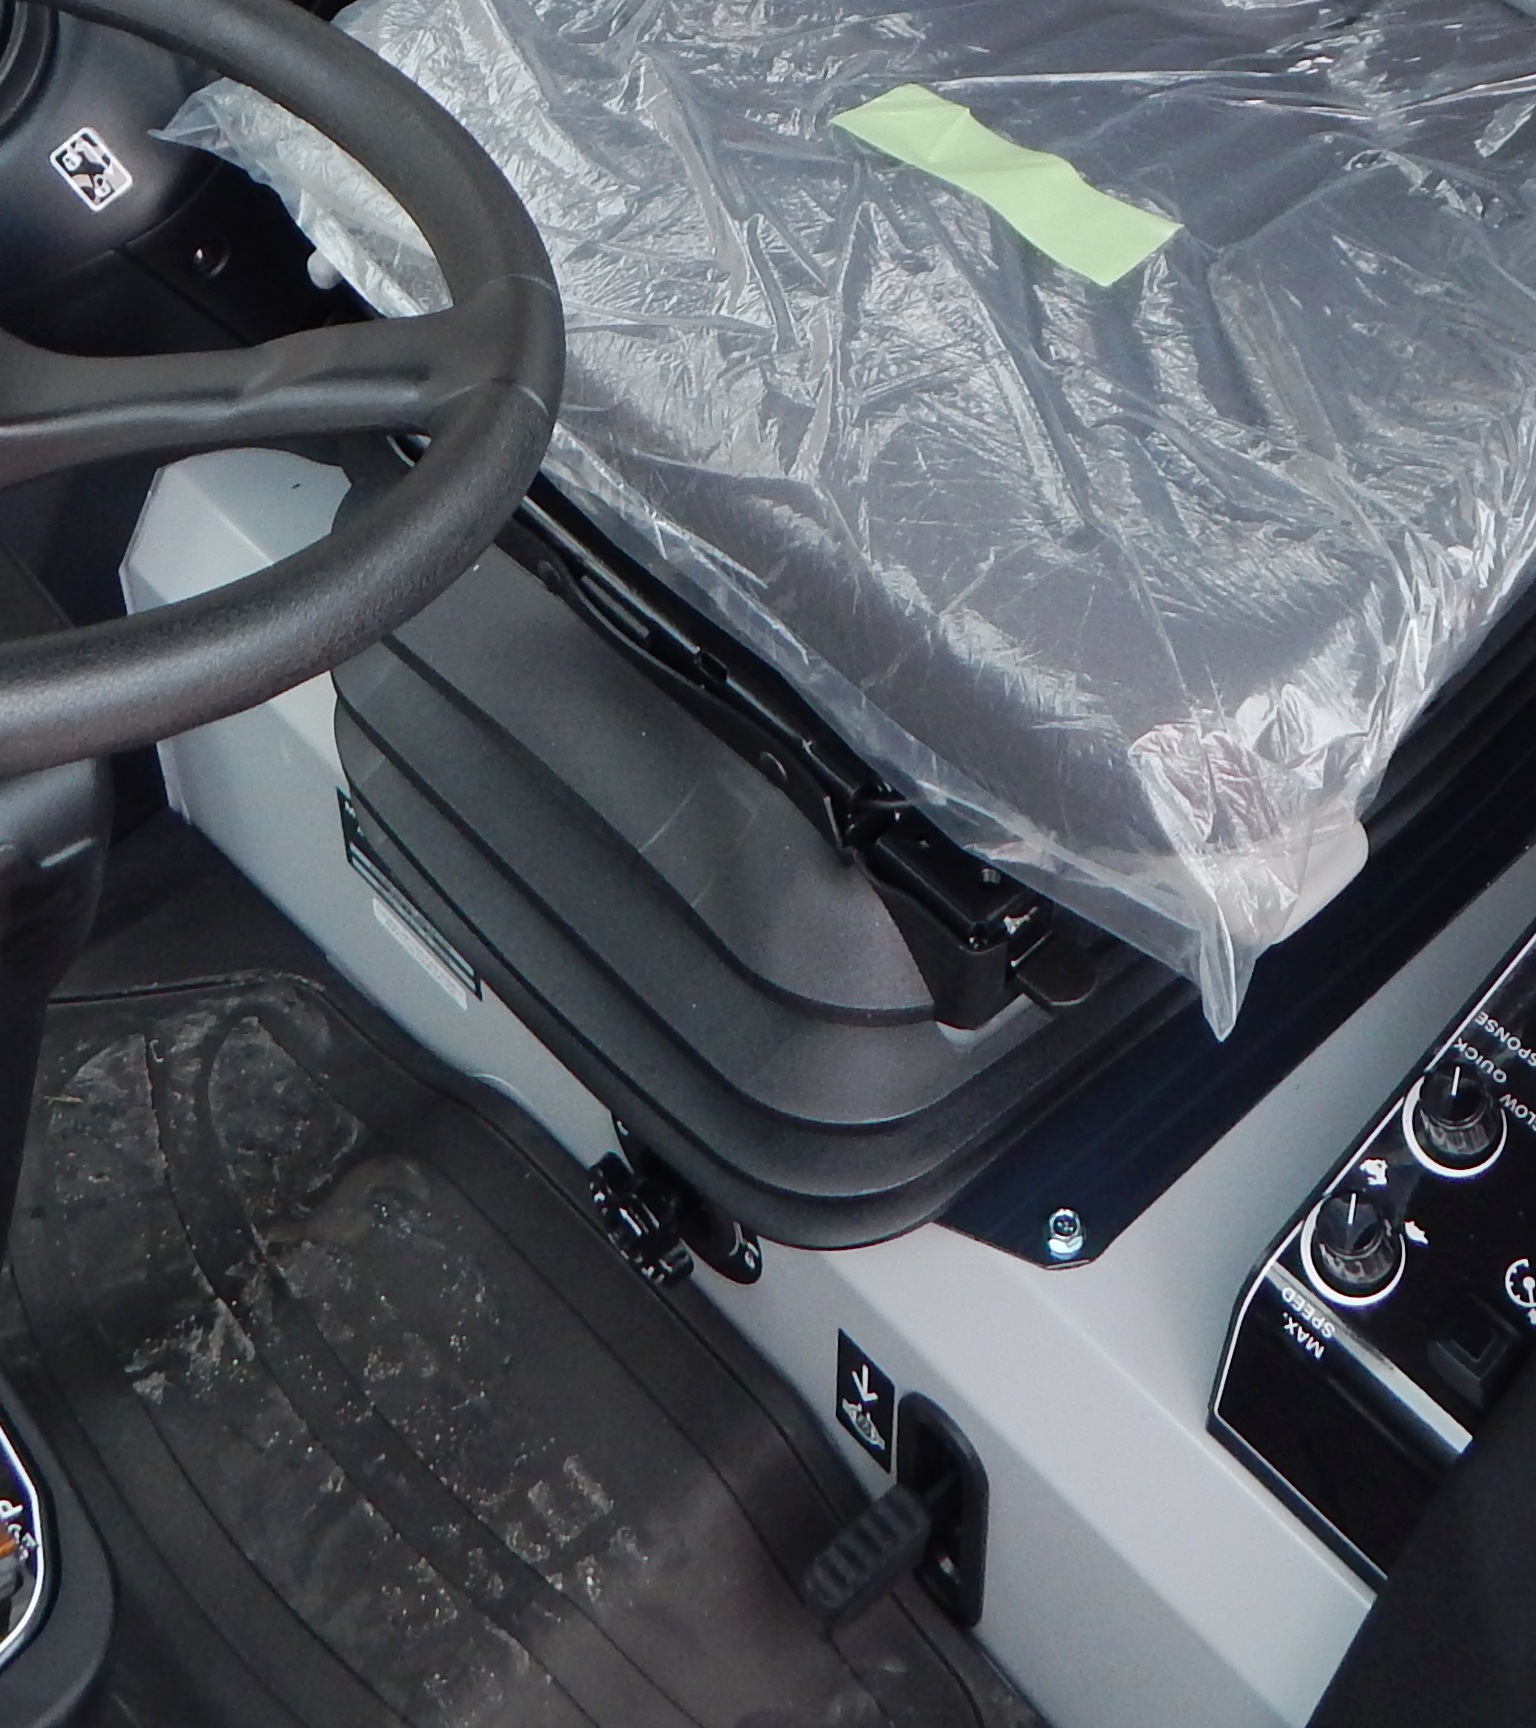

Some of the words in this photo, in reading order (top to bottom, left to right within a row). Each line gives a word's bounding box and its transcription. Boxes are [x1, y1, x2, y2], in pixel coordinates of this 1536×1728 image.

[1453, 1037, 1507, 1083] QUICK
[1282, 1286, 1336, 1338] SPEED
[1283, 1312, 1324, 1359] MAX.
